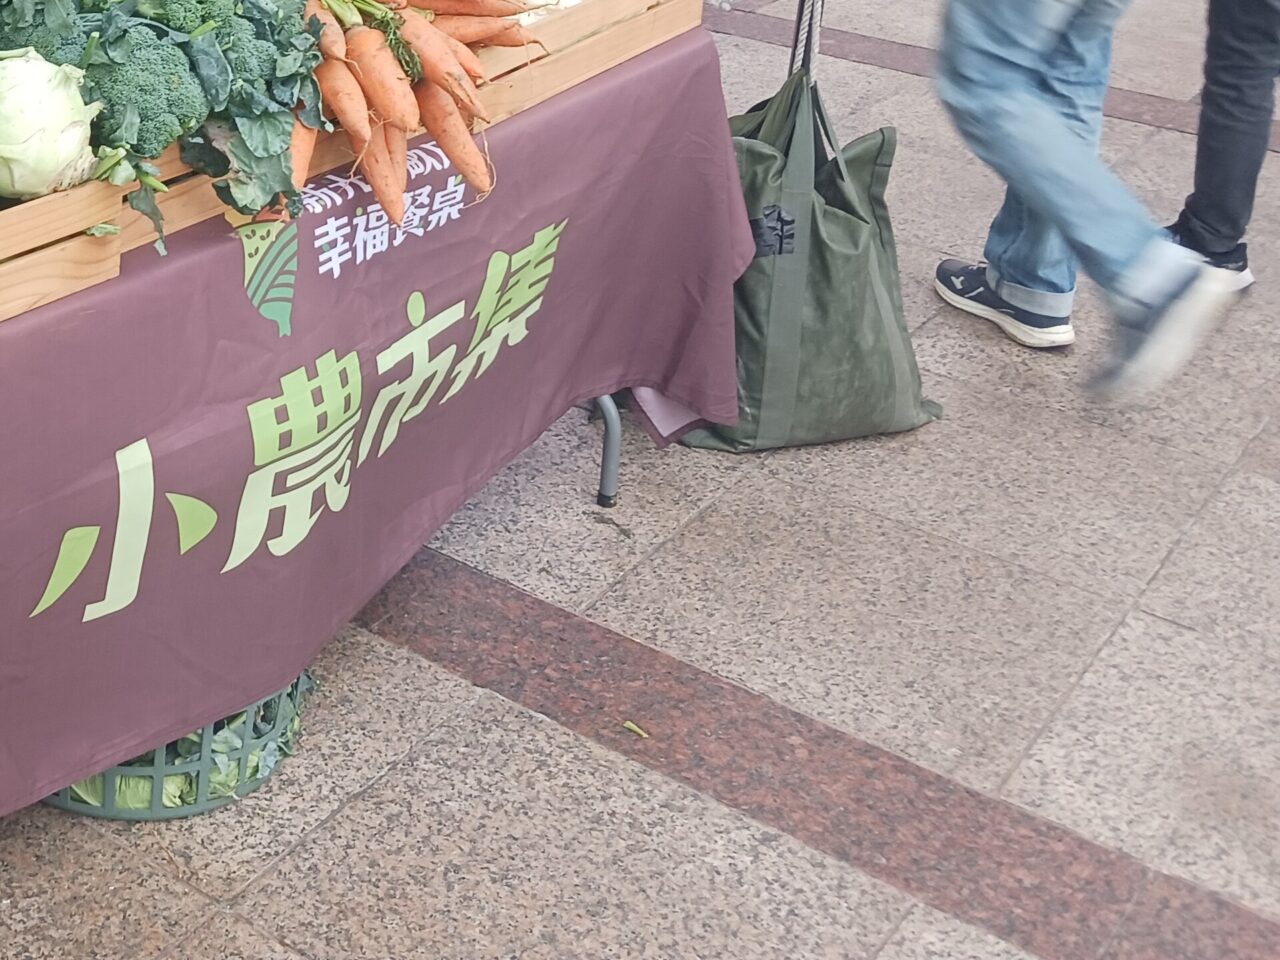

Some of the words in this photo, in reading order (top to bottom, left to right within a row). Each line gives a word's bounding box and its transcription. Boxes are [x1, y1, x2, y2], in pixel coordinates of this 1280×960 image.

[314, 175, 466, 279] 幸福餐桌
[29, 218, 569, 622] 小農市集
